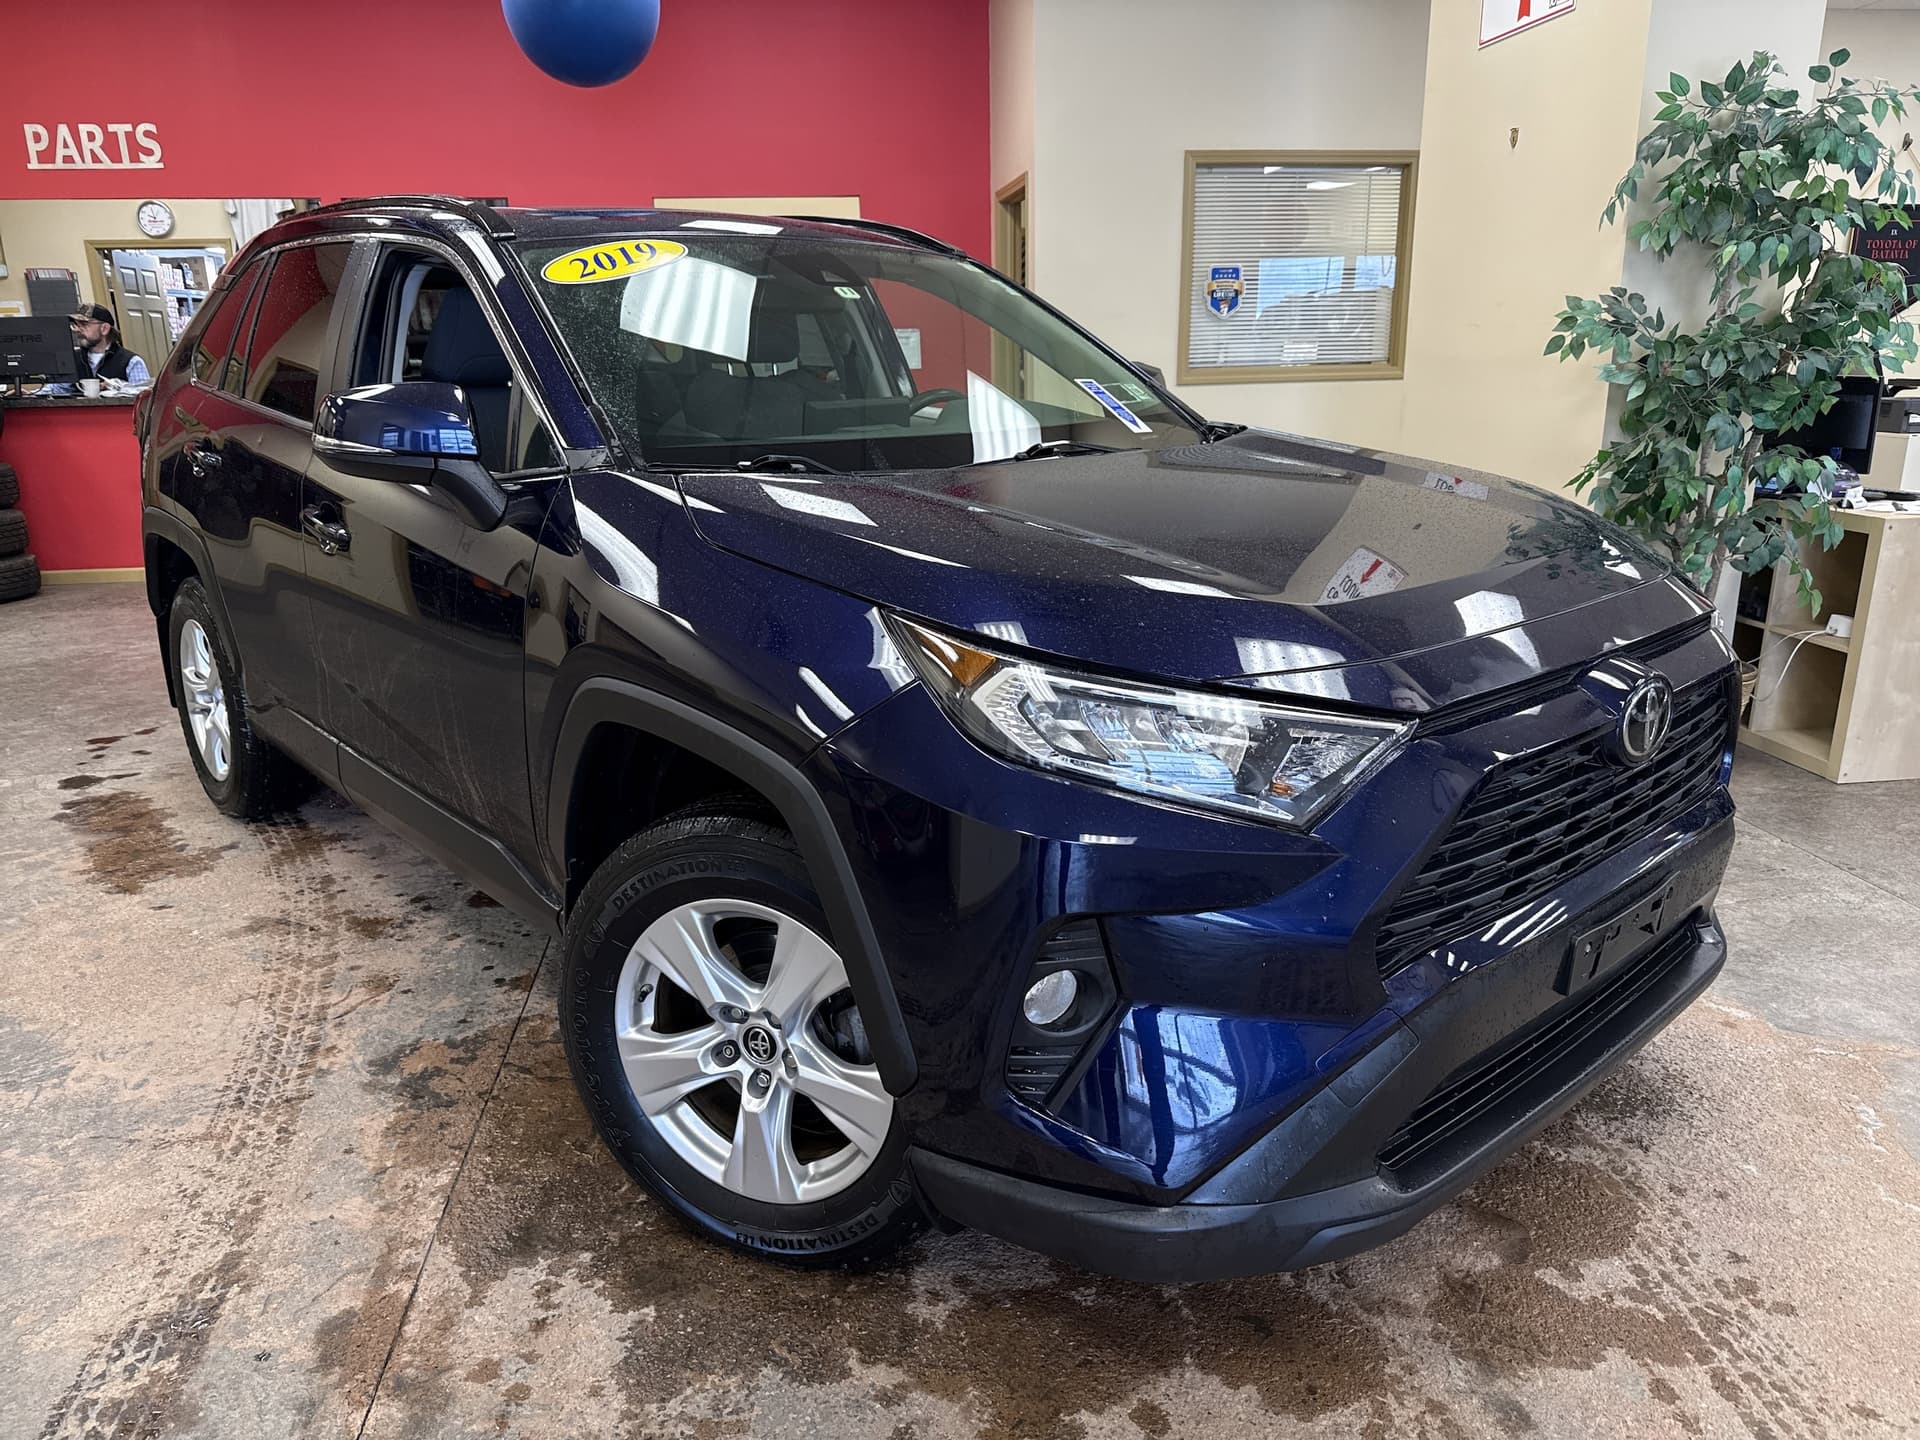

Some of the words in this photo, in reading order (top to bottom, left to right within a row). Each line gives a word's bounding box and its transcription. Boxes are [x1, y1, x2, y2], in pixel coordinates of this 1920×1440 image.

[23, 123, 164, 169] PARTS
[569, 242, 657, 279] 2019
[611, 860, 723, 910] DESTINATION
[757, 1213, 880, 1251] DESTINATION
